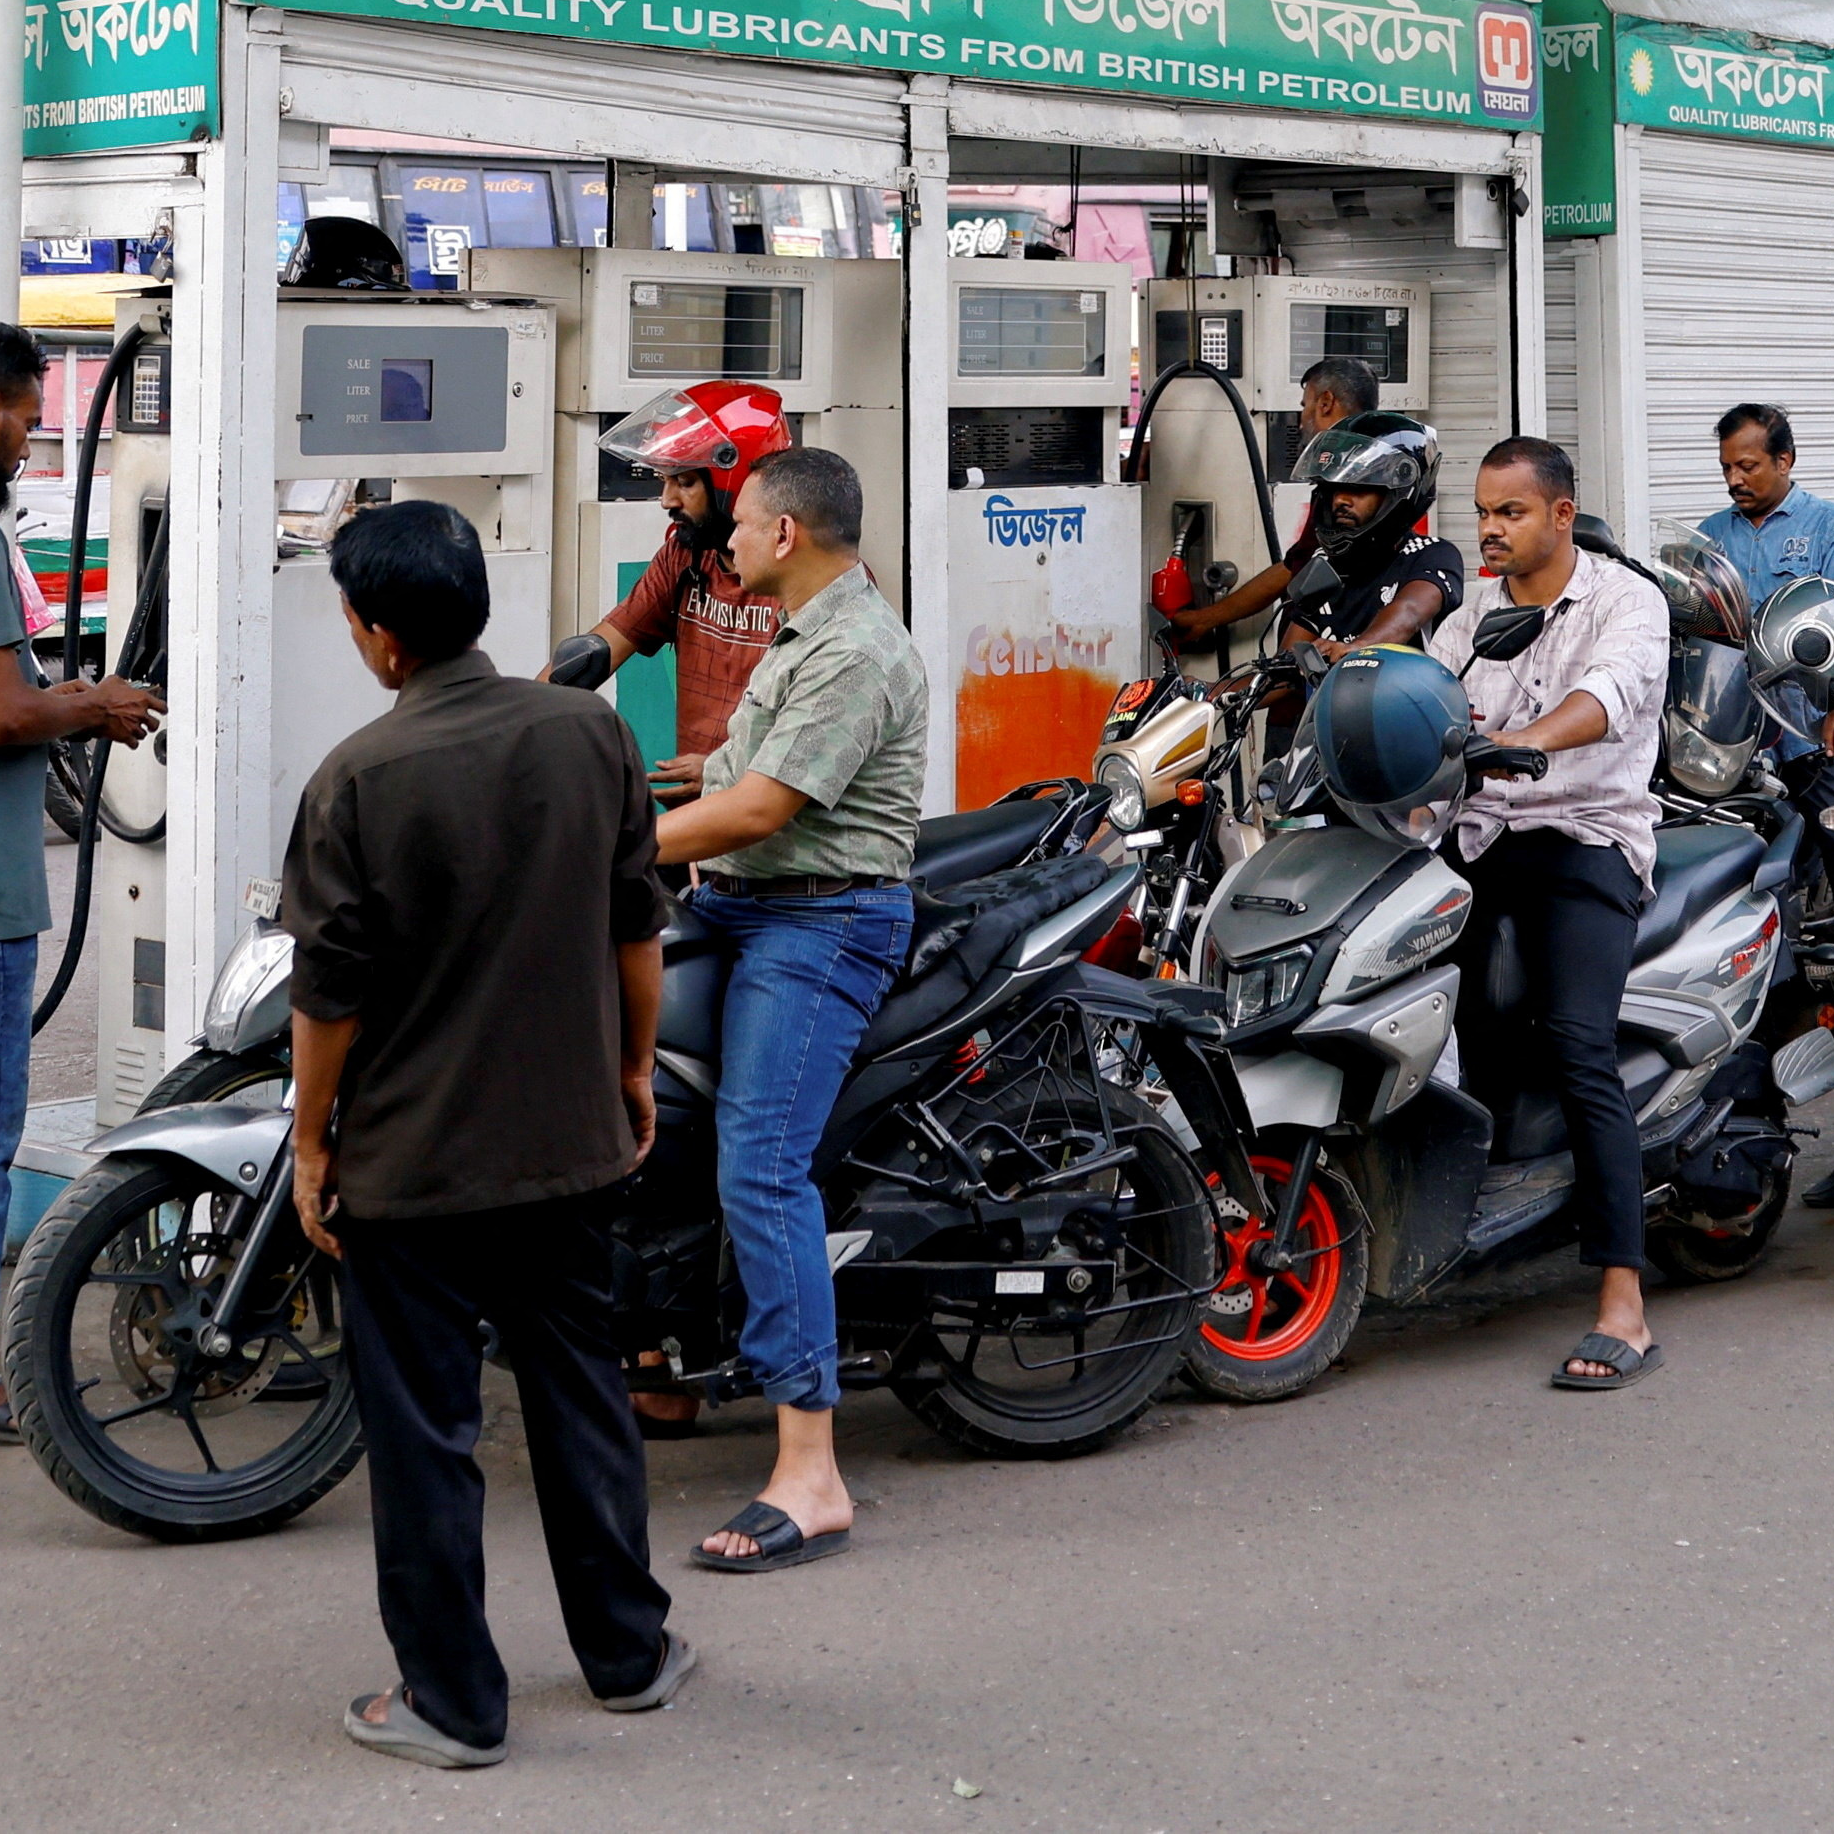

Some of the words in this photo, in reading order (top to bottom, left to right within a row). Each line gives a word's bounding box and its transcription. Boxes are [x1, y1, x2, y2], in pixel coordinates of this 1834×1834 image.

[642, 3, 946, 62] LUBRICANTS
[960, 37, 1085, 75] FROM
[1098, 51, 1246, 92] BRITISH
[1258, 70, 1472, 116] PETROLEUM
[1669, 44, 1831, 117] অকটেন
[42, 100, 75, 128] FROM
[78, 93, 127, 123] BRITISH
[130, 85, 206, 119] PETROLEUM
[1482, 87, 1531, 115] মেঘনা
[1669, 105, 1729, 128] QUALITY
[1732, 112, 1817, 138] LUBRICANTS
[412, 176, 467, 194] সিটি
[1544, 203, 1612, 225] PETROLIUM
[640, 325, 665, 337] LITER
[966, 329, 987, 339] LITER
[346, 357, 371, 370] SALE
[639, 352, 665, 364] PRICE
[346, 385, 371, 397] LITER
[345, 413, 370, 425] PRICE
[983, 495, 1087, 548] ডিজেল
[1412, 923, 1453, 953] YAMAHA
